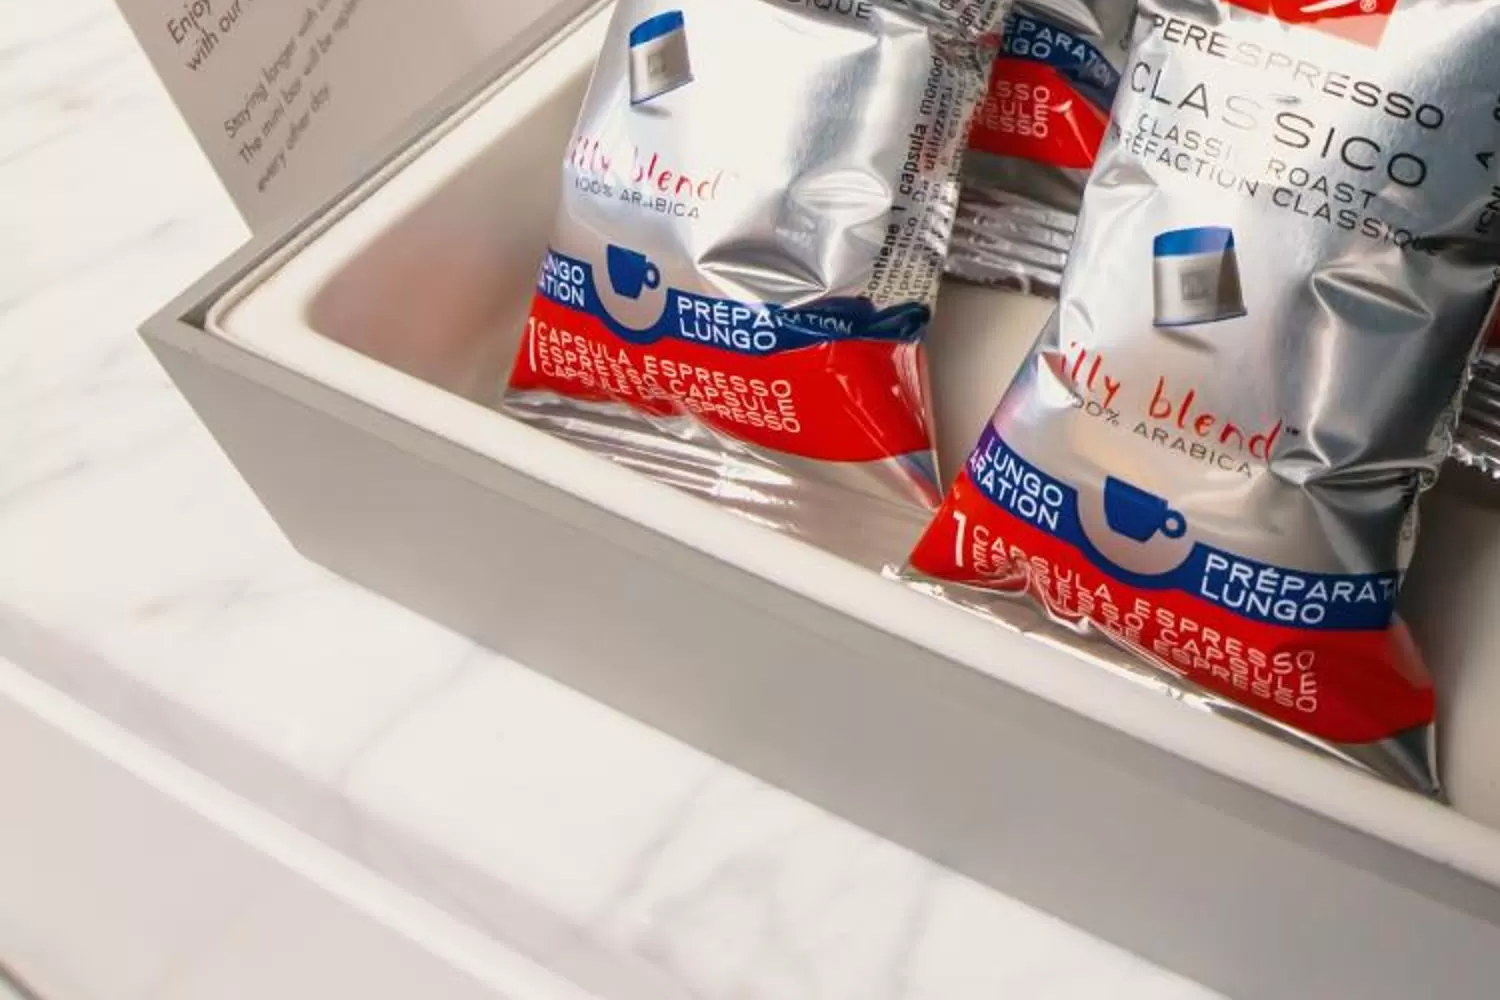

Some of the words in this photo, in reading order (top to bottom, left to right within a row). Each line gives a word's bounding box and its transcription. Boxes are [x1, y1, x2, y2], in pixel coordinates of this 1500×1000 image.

[187, 27, 220, 72] with
[1152, 14, 1446, 130] PERESPRESSO
[239, 136, 263, 165] The
[899, 120, 928, 198] capsula
[918, 54, 946, 118] monod
[1129, 60, 1429, 190] CLASSICO
[1137, 112, 1233, 162] CLASSI
[1266, 158, 1380, 211] ROAST
[1474, 150, 1495, 171] A
[536, 322, 633, 367] CAPSULA
[642, 354, 793, 399] ESPRESSO
[678, 317, 778, 352] LUNGO
[669, 379, 798, 419] CAPSULE
[1060, 341, 1121, 409] illy
[1148, 374, 1283, 464] blend
[1069, 389, 1122, 428] 00%
[1131, 420, 1254, 479] ARABICA
[968, 448, 1060, 532] ARATION
[984, 435, 1064, 508] LUNGO
[952, 510, 968, 568] 1
[1134, 598, 1316, 677] ESPRESSO
[1200, 575, 1326, 625] LUNGO
[1159, 628, 1318, 696] CAPSULE
